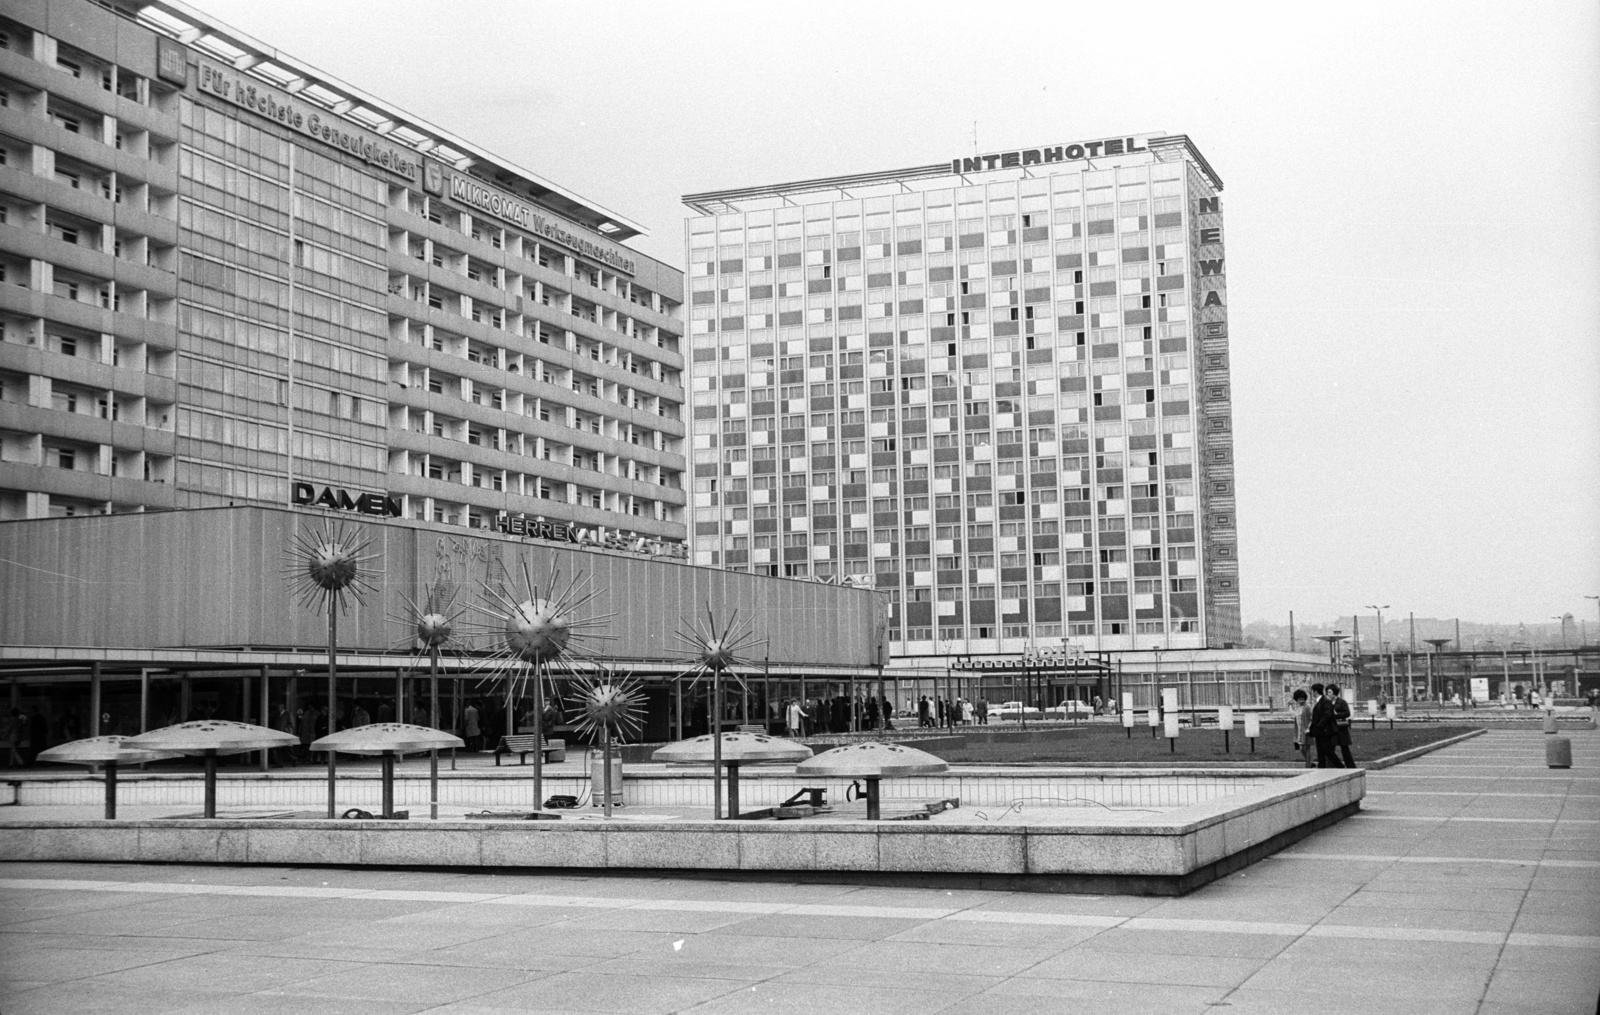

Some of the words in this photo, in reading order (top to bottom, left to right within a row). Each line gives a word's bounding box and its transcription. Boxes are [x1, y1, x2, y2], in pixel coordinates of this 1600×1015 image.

[201, 64, 230, 97] Für
[235, 80, 303, 129] höchste
[306, 113, 416, 178] Genauigkeiten
[952, 137, 1147, 173] INTERHOTEL
[452, 174, 530, 228] MIKROMAT
[532, 213, 636, 274] Werkzeugmaschinen
[1199, 196, 1223, 307] NEWA
[291, 482, 402, 518] DAMEN
